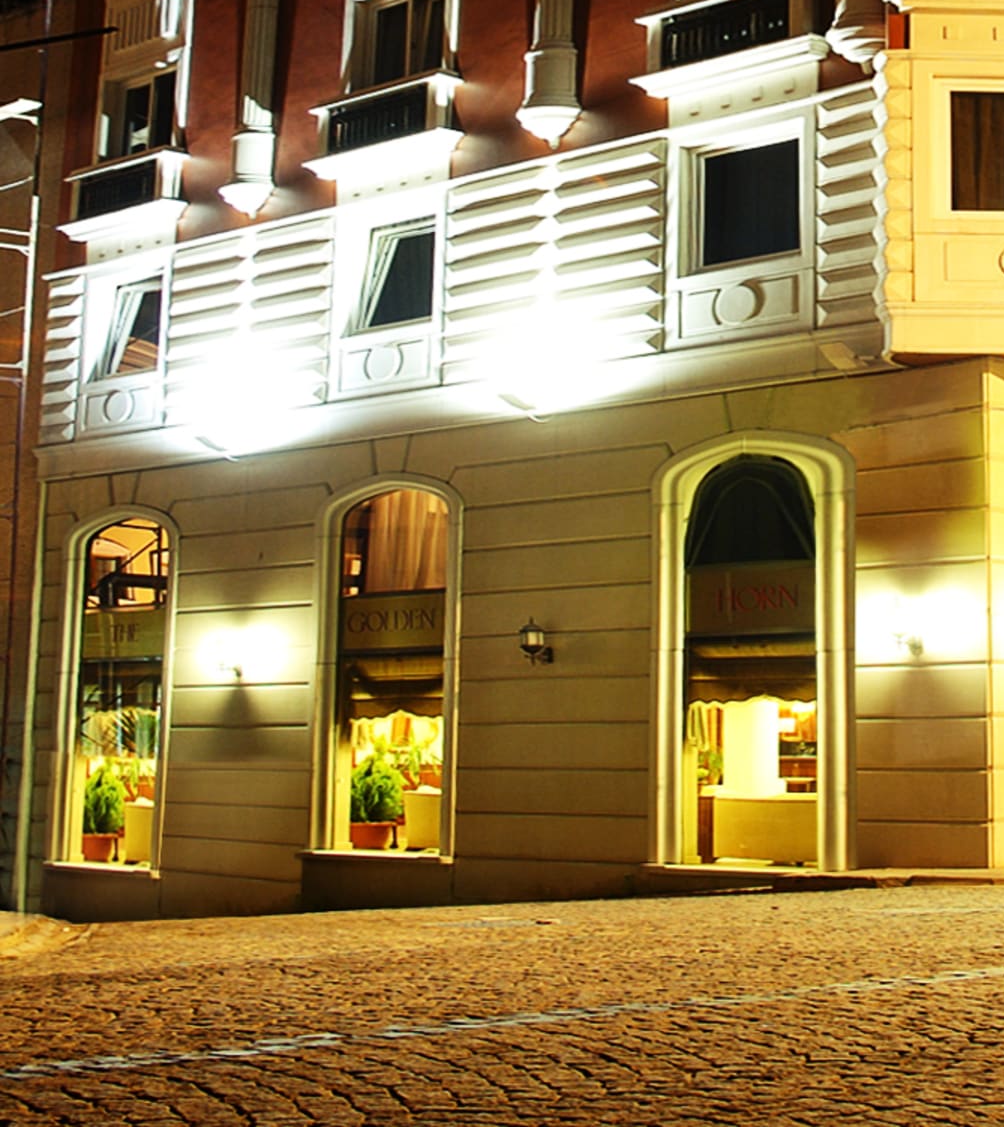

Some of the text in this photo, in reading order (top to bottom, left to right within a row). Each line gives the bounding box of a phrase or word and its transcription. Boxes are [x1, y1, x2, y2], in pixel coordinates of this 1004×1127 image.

[715, 583, 799, 615] HORN
[110, 623, 140, 642] THE
[347, 607, 436, 633] GOLDEN
